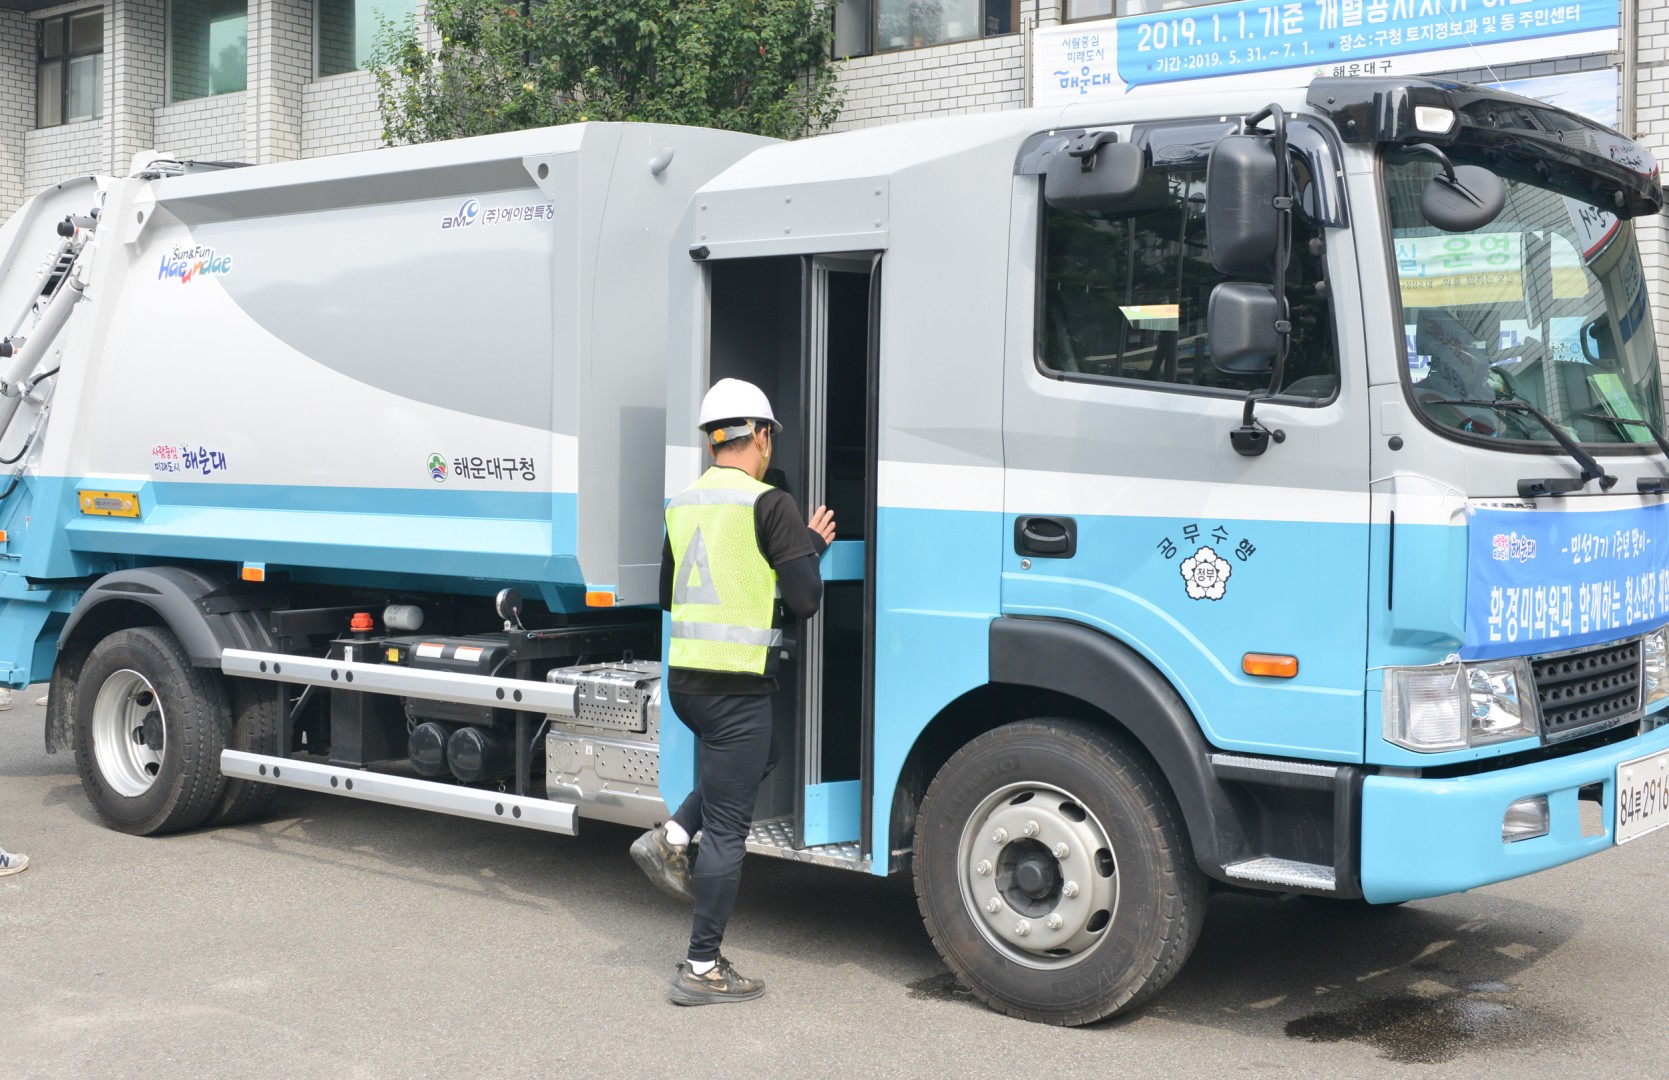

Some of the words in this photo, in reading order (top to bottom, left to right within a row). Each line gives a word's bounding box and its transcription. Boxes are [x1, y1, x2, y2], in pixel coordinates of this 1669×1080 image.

[1062, 34, 1100, 50] 사람중심
[1137, 17, 1202, 52] 2019.
[1302, 41, 1315, 56] 1.
[1405, 18, 1478, 41] 토지정보과
[1482, 15, 1497, 34] 및
[1501, 13, 1516, 31] 동
[1519, 4, 1581, 29] 주민센터
[1067, 48, 1105, 64] 미래도시
[1332, 60, 1393, 77] 해운대구
[1053, 65, 1112, 95] 해운대
[172, 245, 211, 261] Sun&Fun
[1431, 236, 1511, 269] 운영
[158, 250, 232, 285] Haeundae
[152, 445, 179, 460] 사람중심
[181, 445, 227, 476] 해운대
[154, 460, 181, 473] 미래도시
[453, 456, 536, 481] 해운대구청
[1156, 523, 1257, 562] 공무수행
[1197, 568, 1215, 582] 정부
[1488, 585, 1573, 642] 환경미화원과
[1579, 580, 1621, 634] 함께하는
[1625, 571, 1656, 626] 청소현장
